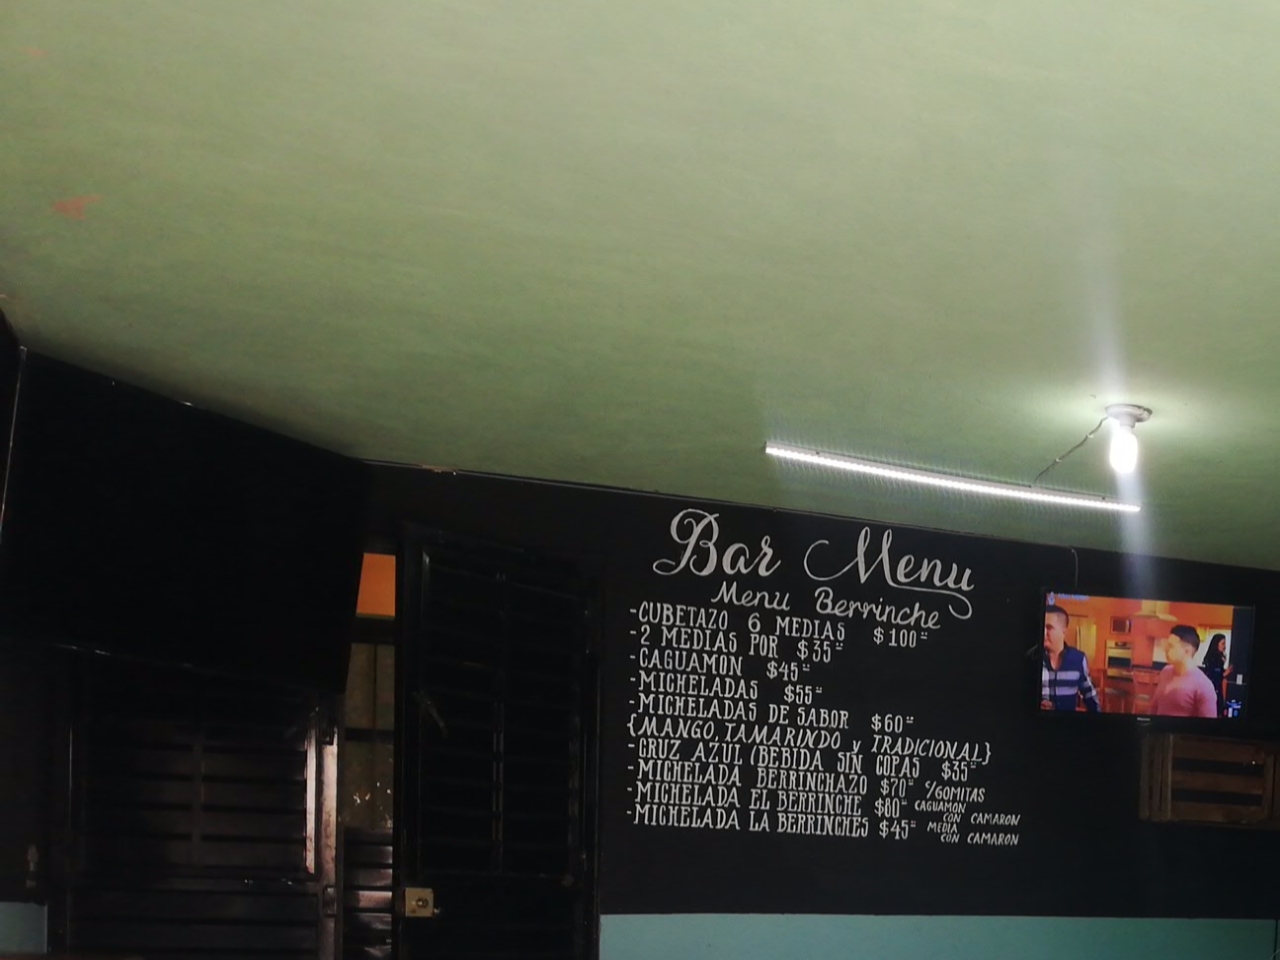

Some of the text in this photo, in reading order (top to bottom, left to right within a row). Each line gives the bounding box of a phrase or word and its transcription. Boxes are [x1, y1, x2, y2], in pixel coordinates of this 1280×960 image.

[653, 508, 974, 620] Bar Menu
[711, 581, 940, 629] Menu Berrinche
[748, 612, 761, 633] 6
[775, 616, 846, 641] MEDIAS
[661, 626, 737, 653] MEDIAS
[749, 633, 778, 658] POR
[768, 704, 789, 724] DE
[797, 707, 849, 729] SABOR
[725, 722, 841, 749] TAMARINDO
[691, 741, 743, 765] AZUL
[837, 752, 863, 774] SIN
[876, 755, 920, 778] COPAS
[756, 768, 868, 795] BERRINCHAZO
[749, 789, 770, 810] EL
[777, 790, 862, 816] BERRINCHE
[914, 800, 967, 814] CAGUAMON
[749, 811, 770, 832] LA
[777, 812, 869, 838] BERRINCHES
[926, 821, 958, 834] MEDIA
[943, 812, 1020, 826] CON CAMARON
[940, 832, 1019, 846] CON CAMARON
